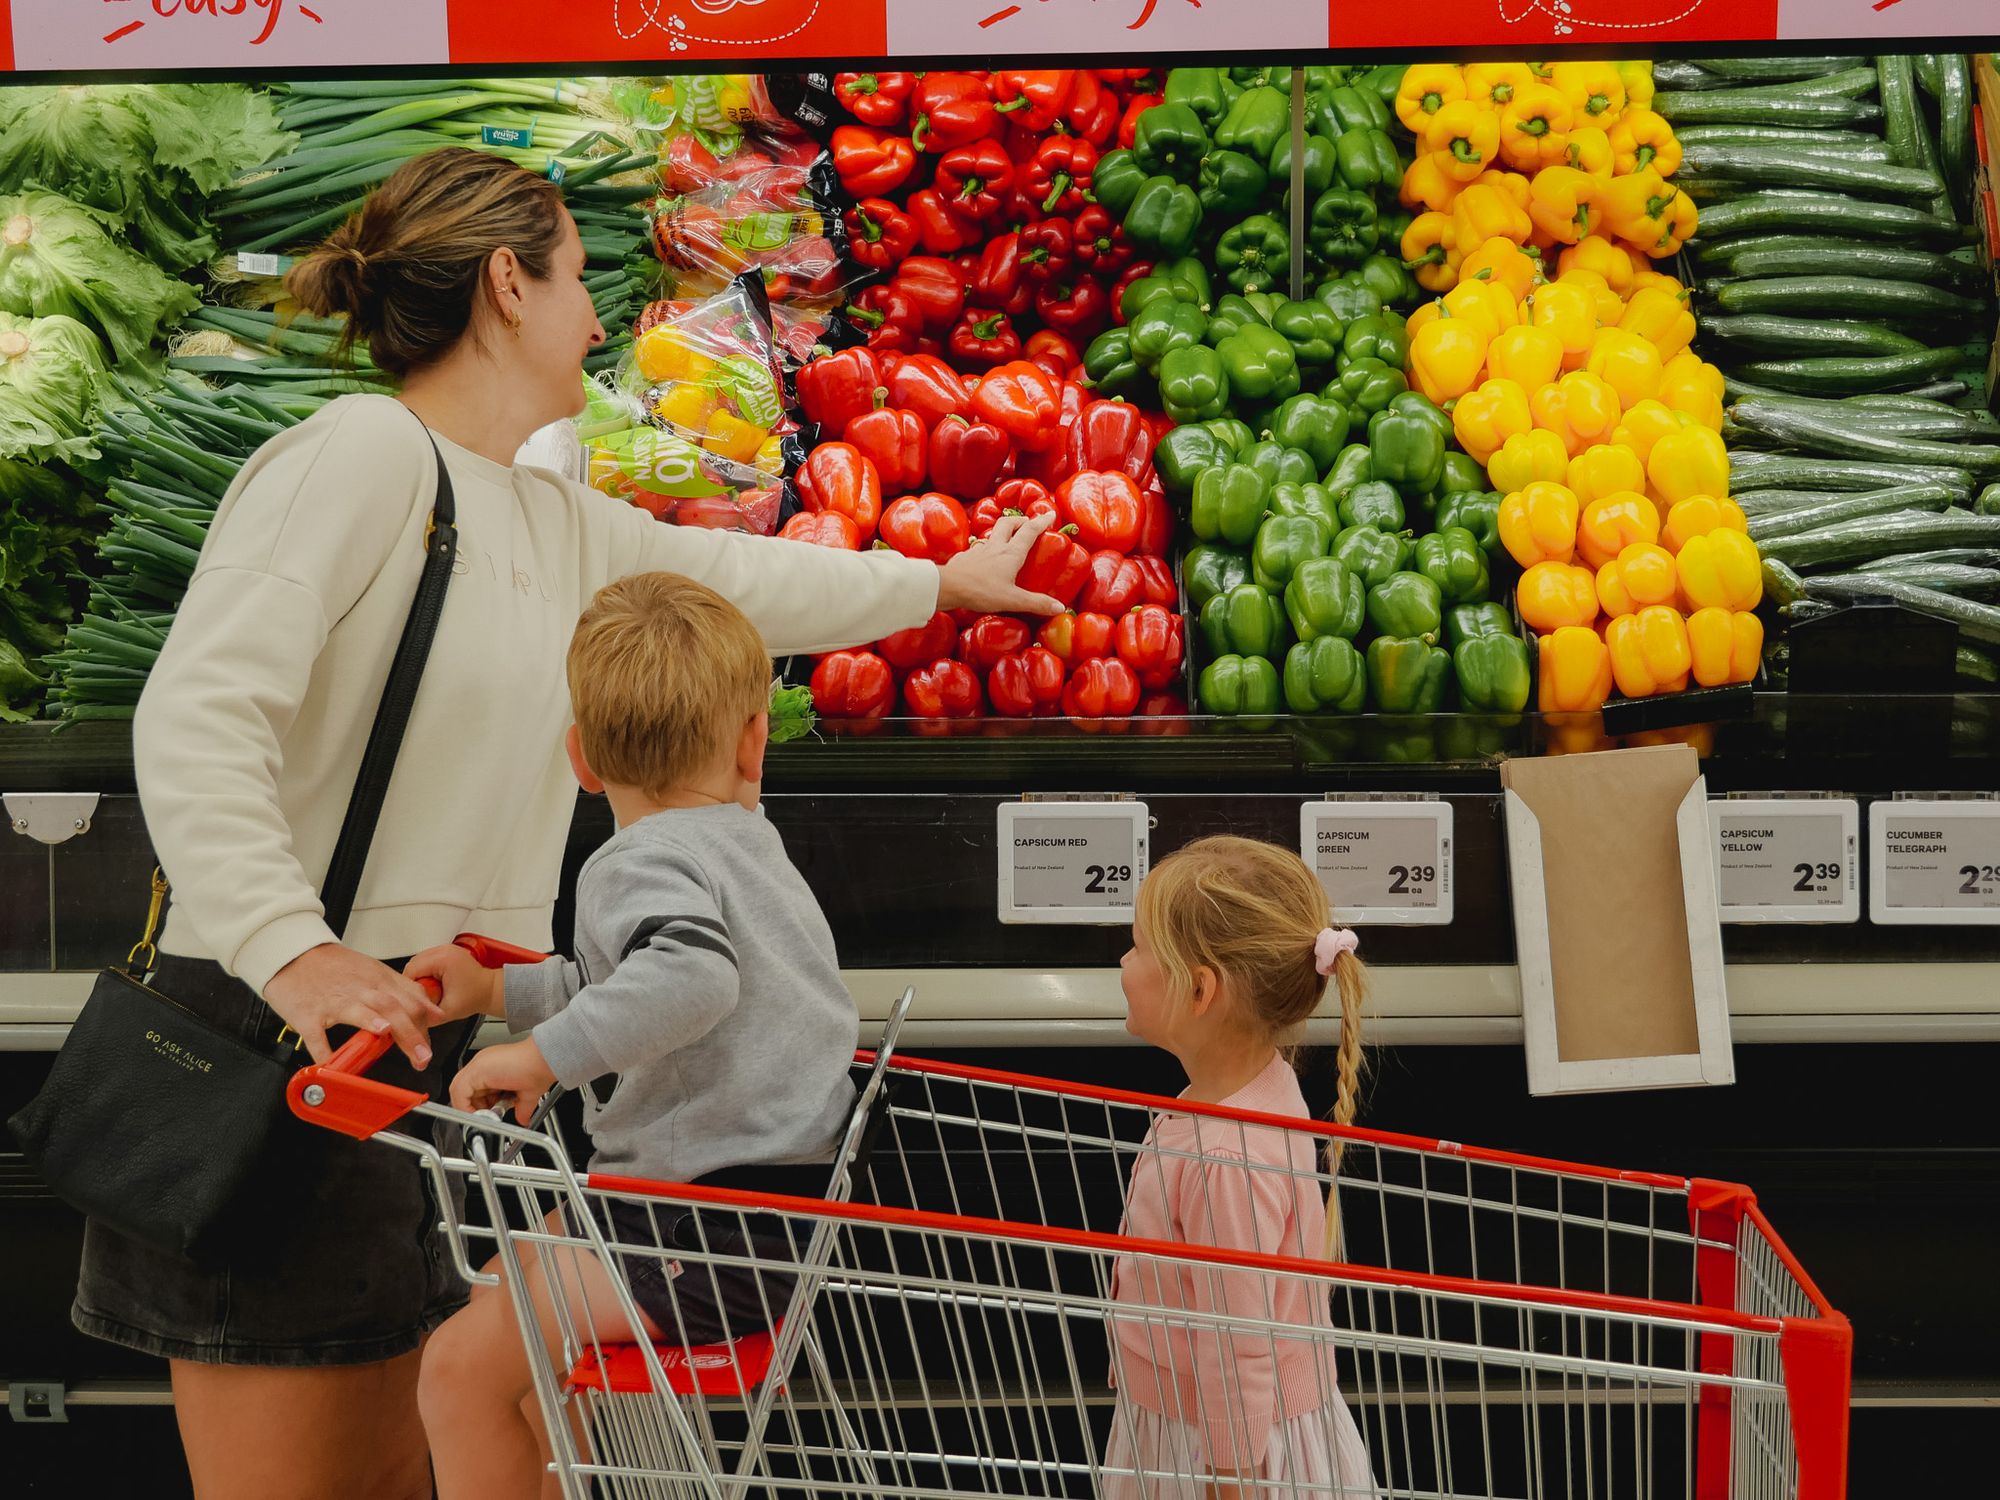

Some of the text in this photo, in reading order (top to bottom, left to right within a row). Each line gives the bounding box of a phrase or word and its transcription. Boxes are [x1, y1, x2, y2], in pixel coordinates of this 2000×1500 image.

[1014, 838, 1088, 847] CAPSICUM RED
[1317, 832, 1370, 840] CAPSICUM
[1721, 830, 1774, 838] CAPSICUM
[1886, 831, 1943, 839] CUCUMBER
[1886, 845, 1947, 853] TELEGRAPH
[1085, 865, 1131, 893] 2 29
[1389, 866, 1435, 893] 2 39
[1793, 863, 1840, 891] 2 39
[1959, 865, 1979, 893] 2
[146, 1031, 212, 1072] GO ASK ALICE
